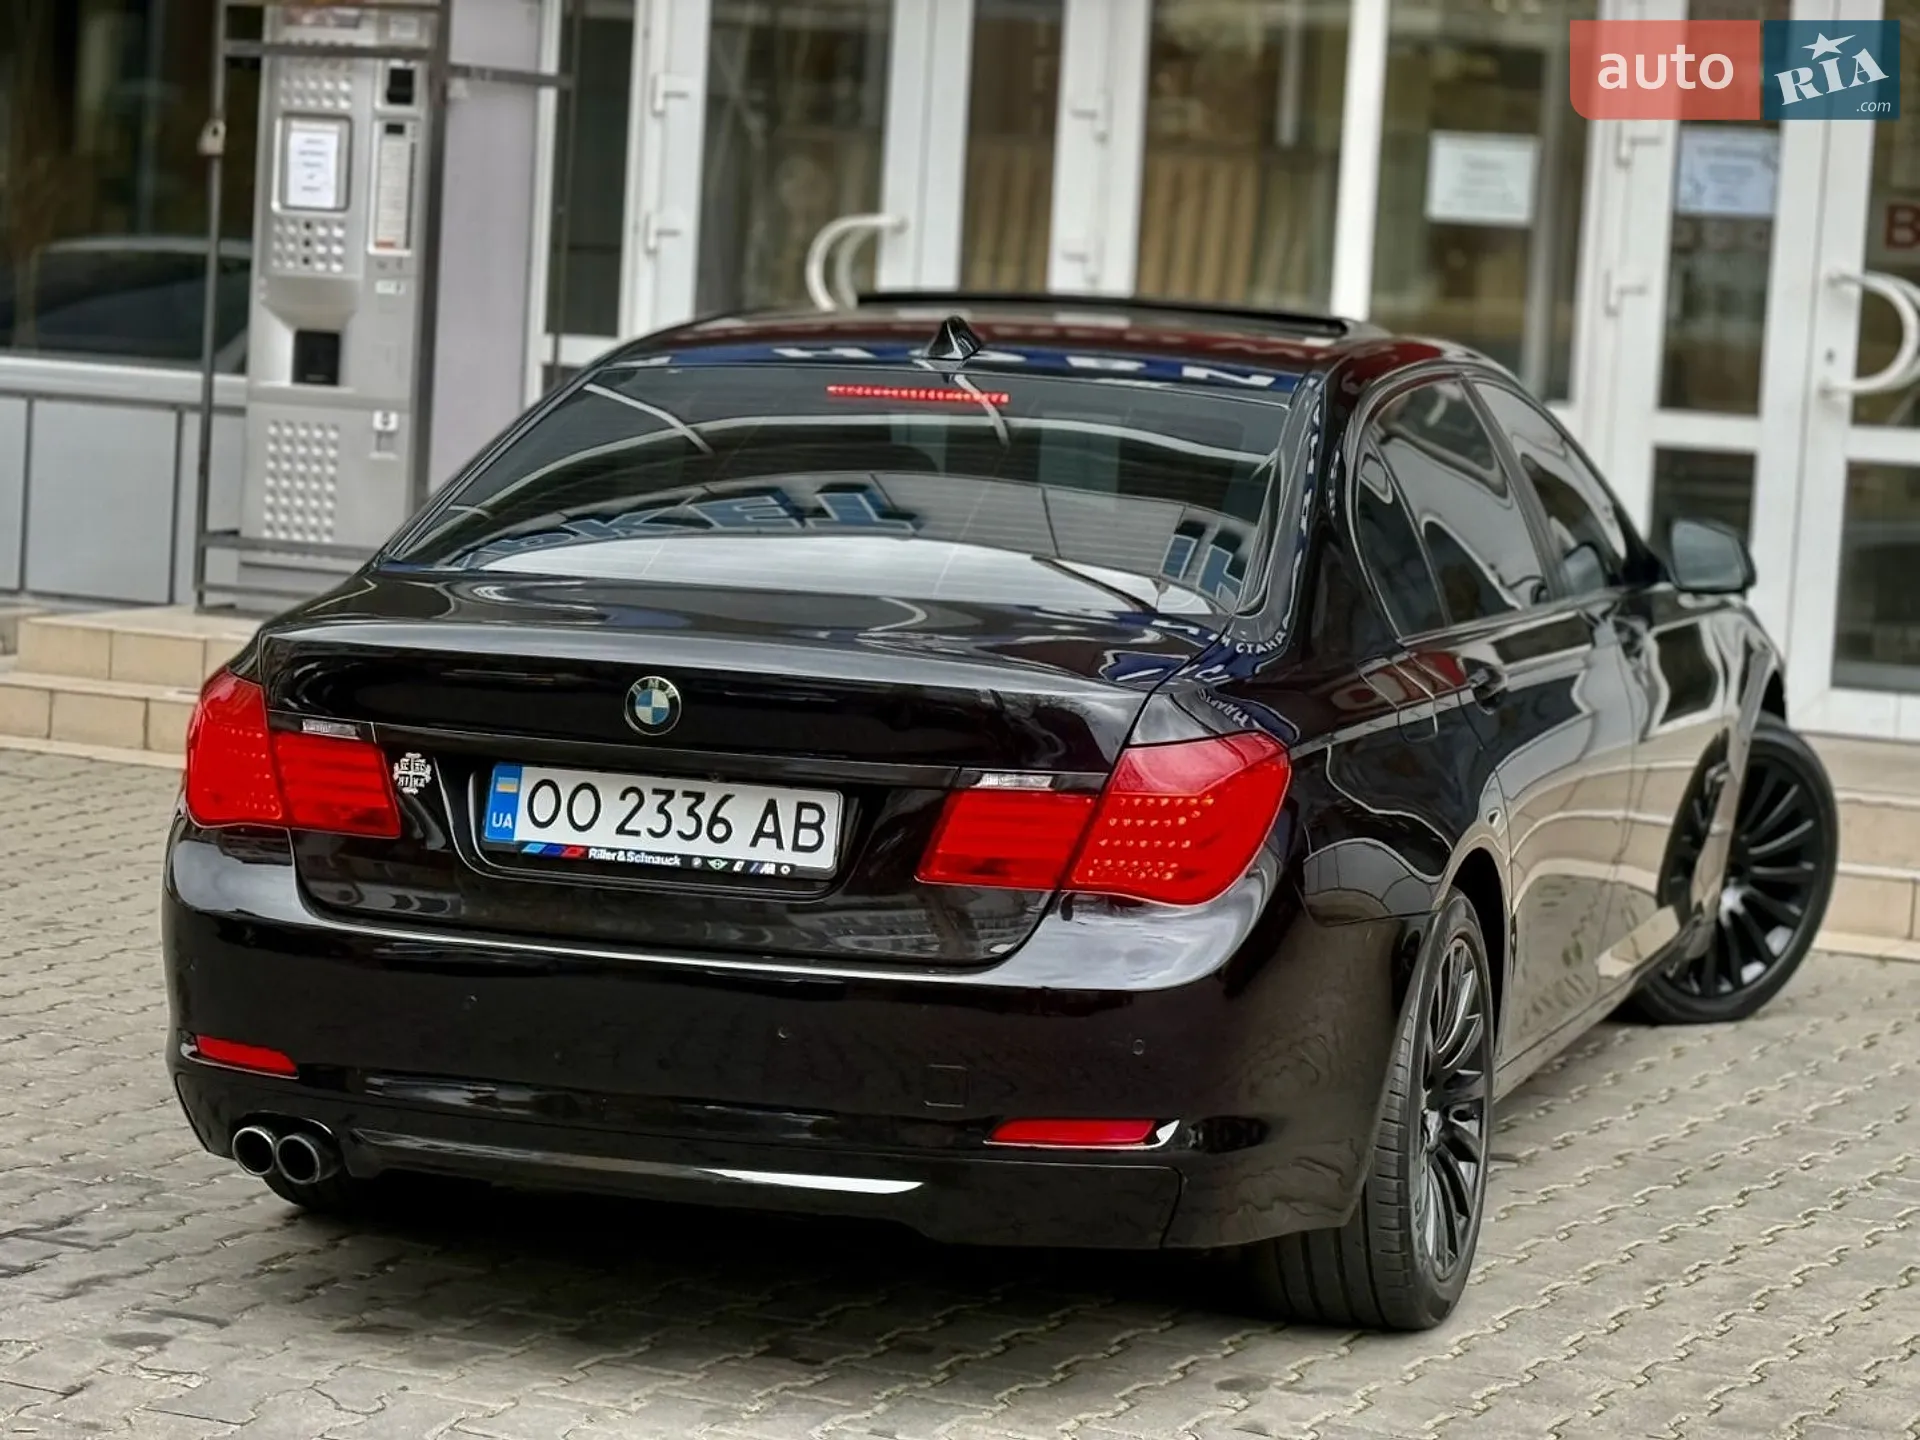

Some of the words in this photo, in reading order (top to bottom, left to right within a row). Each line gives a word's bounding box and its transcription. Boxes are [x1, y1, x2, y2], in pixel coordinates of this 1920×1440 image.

[491, 812, 513, 830] UA
[527, 778, 601, 833] OO
[615, 786, 735, 844] 2336
[749, 798, 827, 853] AB
